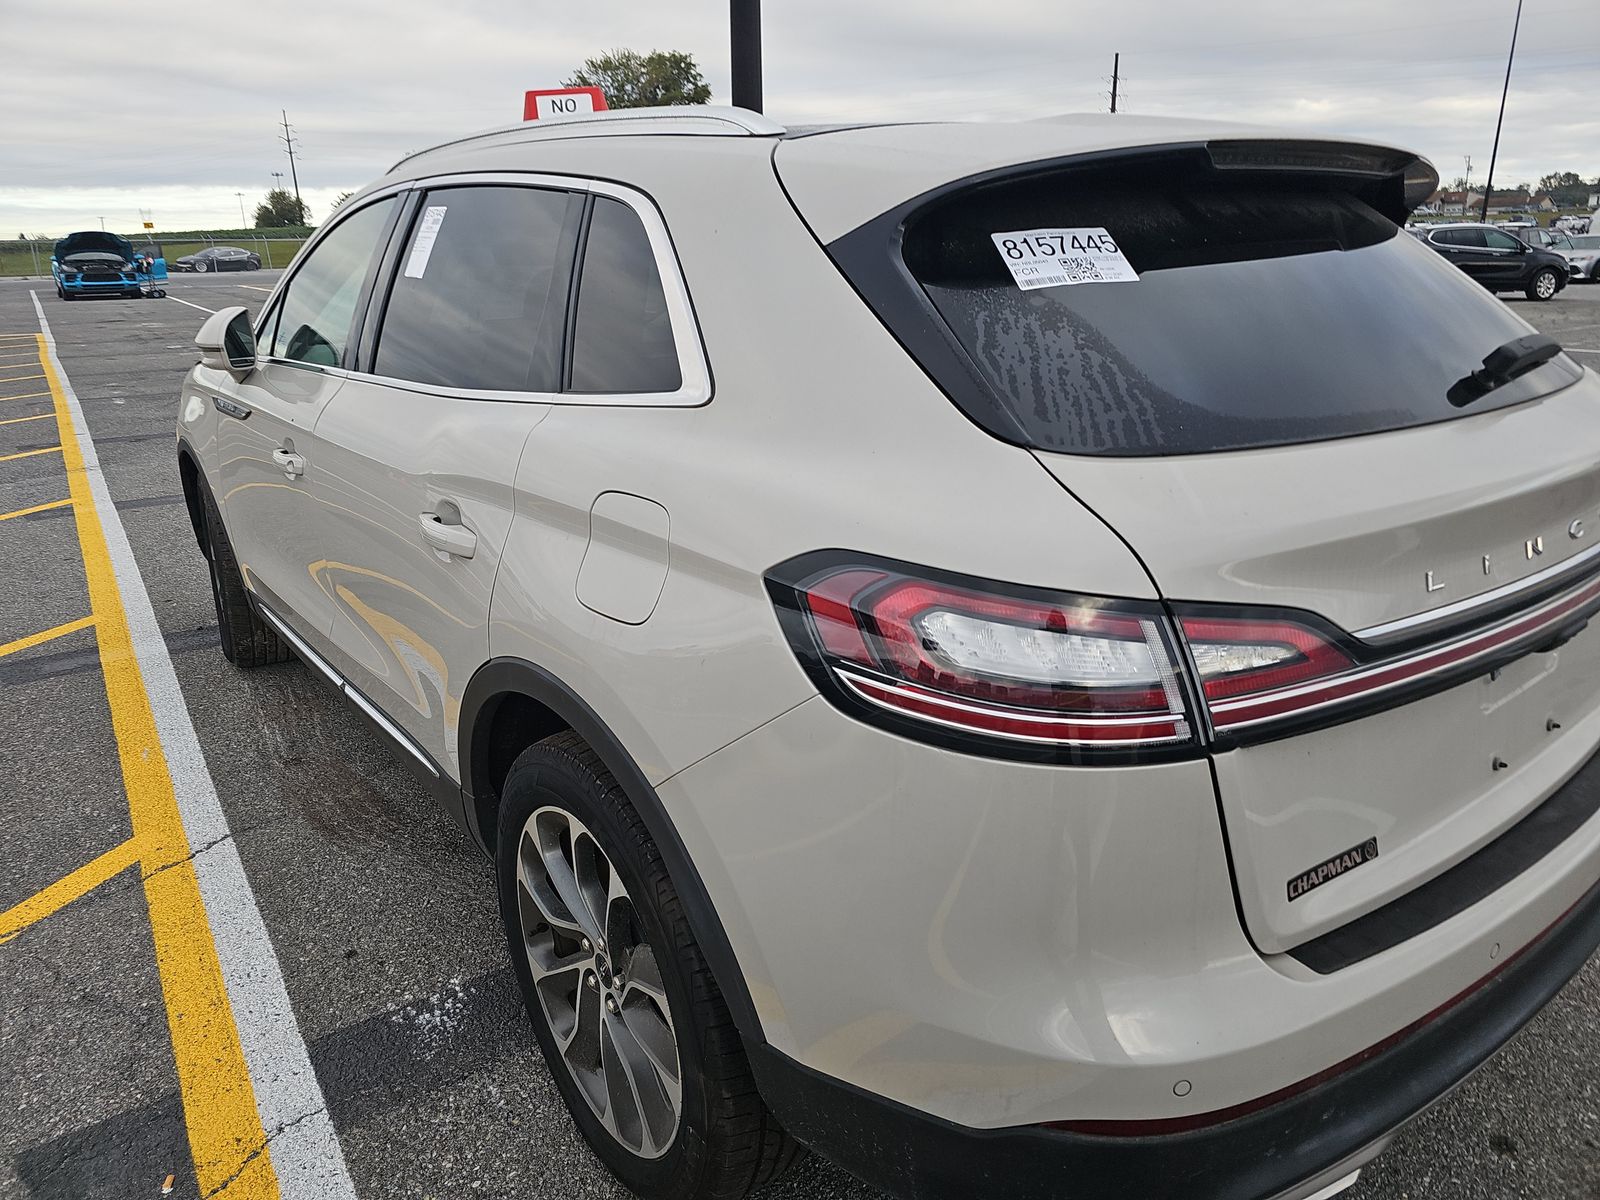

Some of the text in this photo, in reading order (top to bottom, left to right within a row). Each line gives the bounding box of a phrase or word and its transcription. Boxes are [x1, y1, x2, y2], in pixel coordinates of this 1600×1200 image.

[551, 98, 577, 113] NO
[1002, 234, 1118, 260] 8157445
[1425, 517, 1588, 592] LINC
[1289, 848, 1363, 898] CHAPMAN
